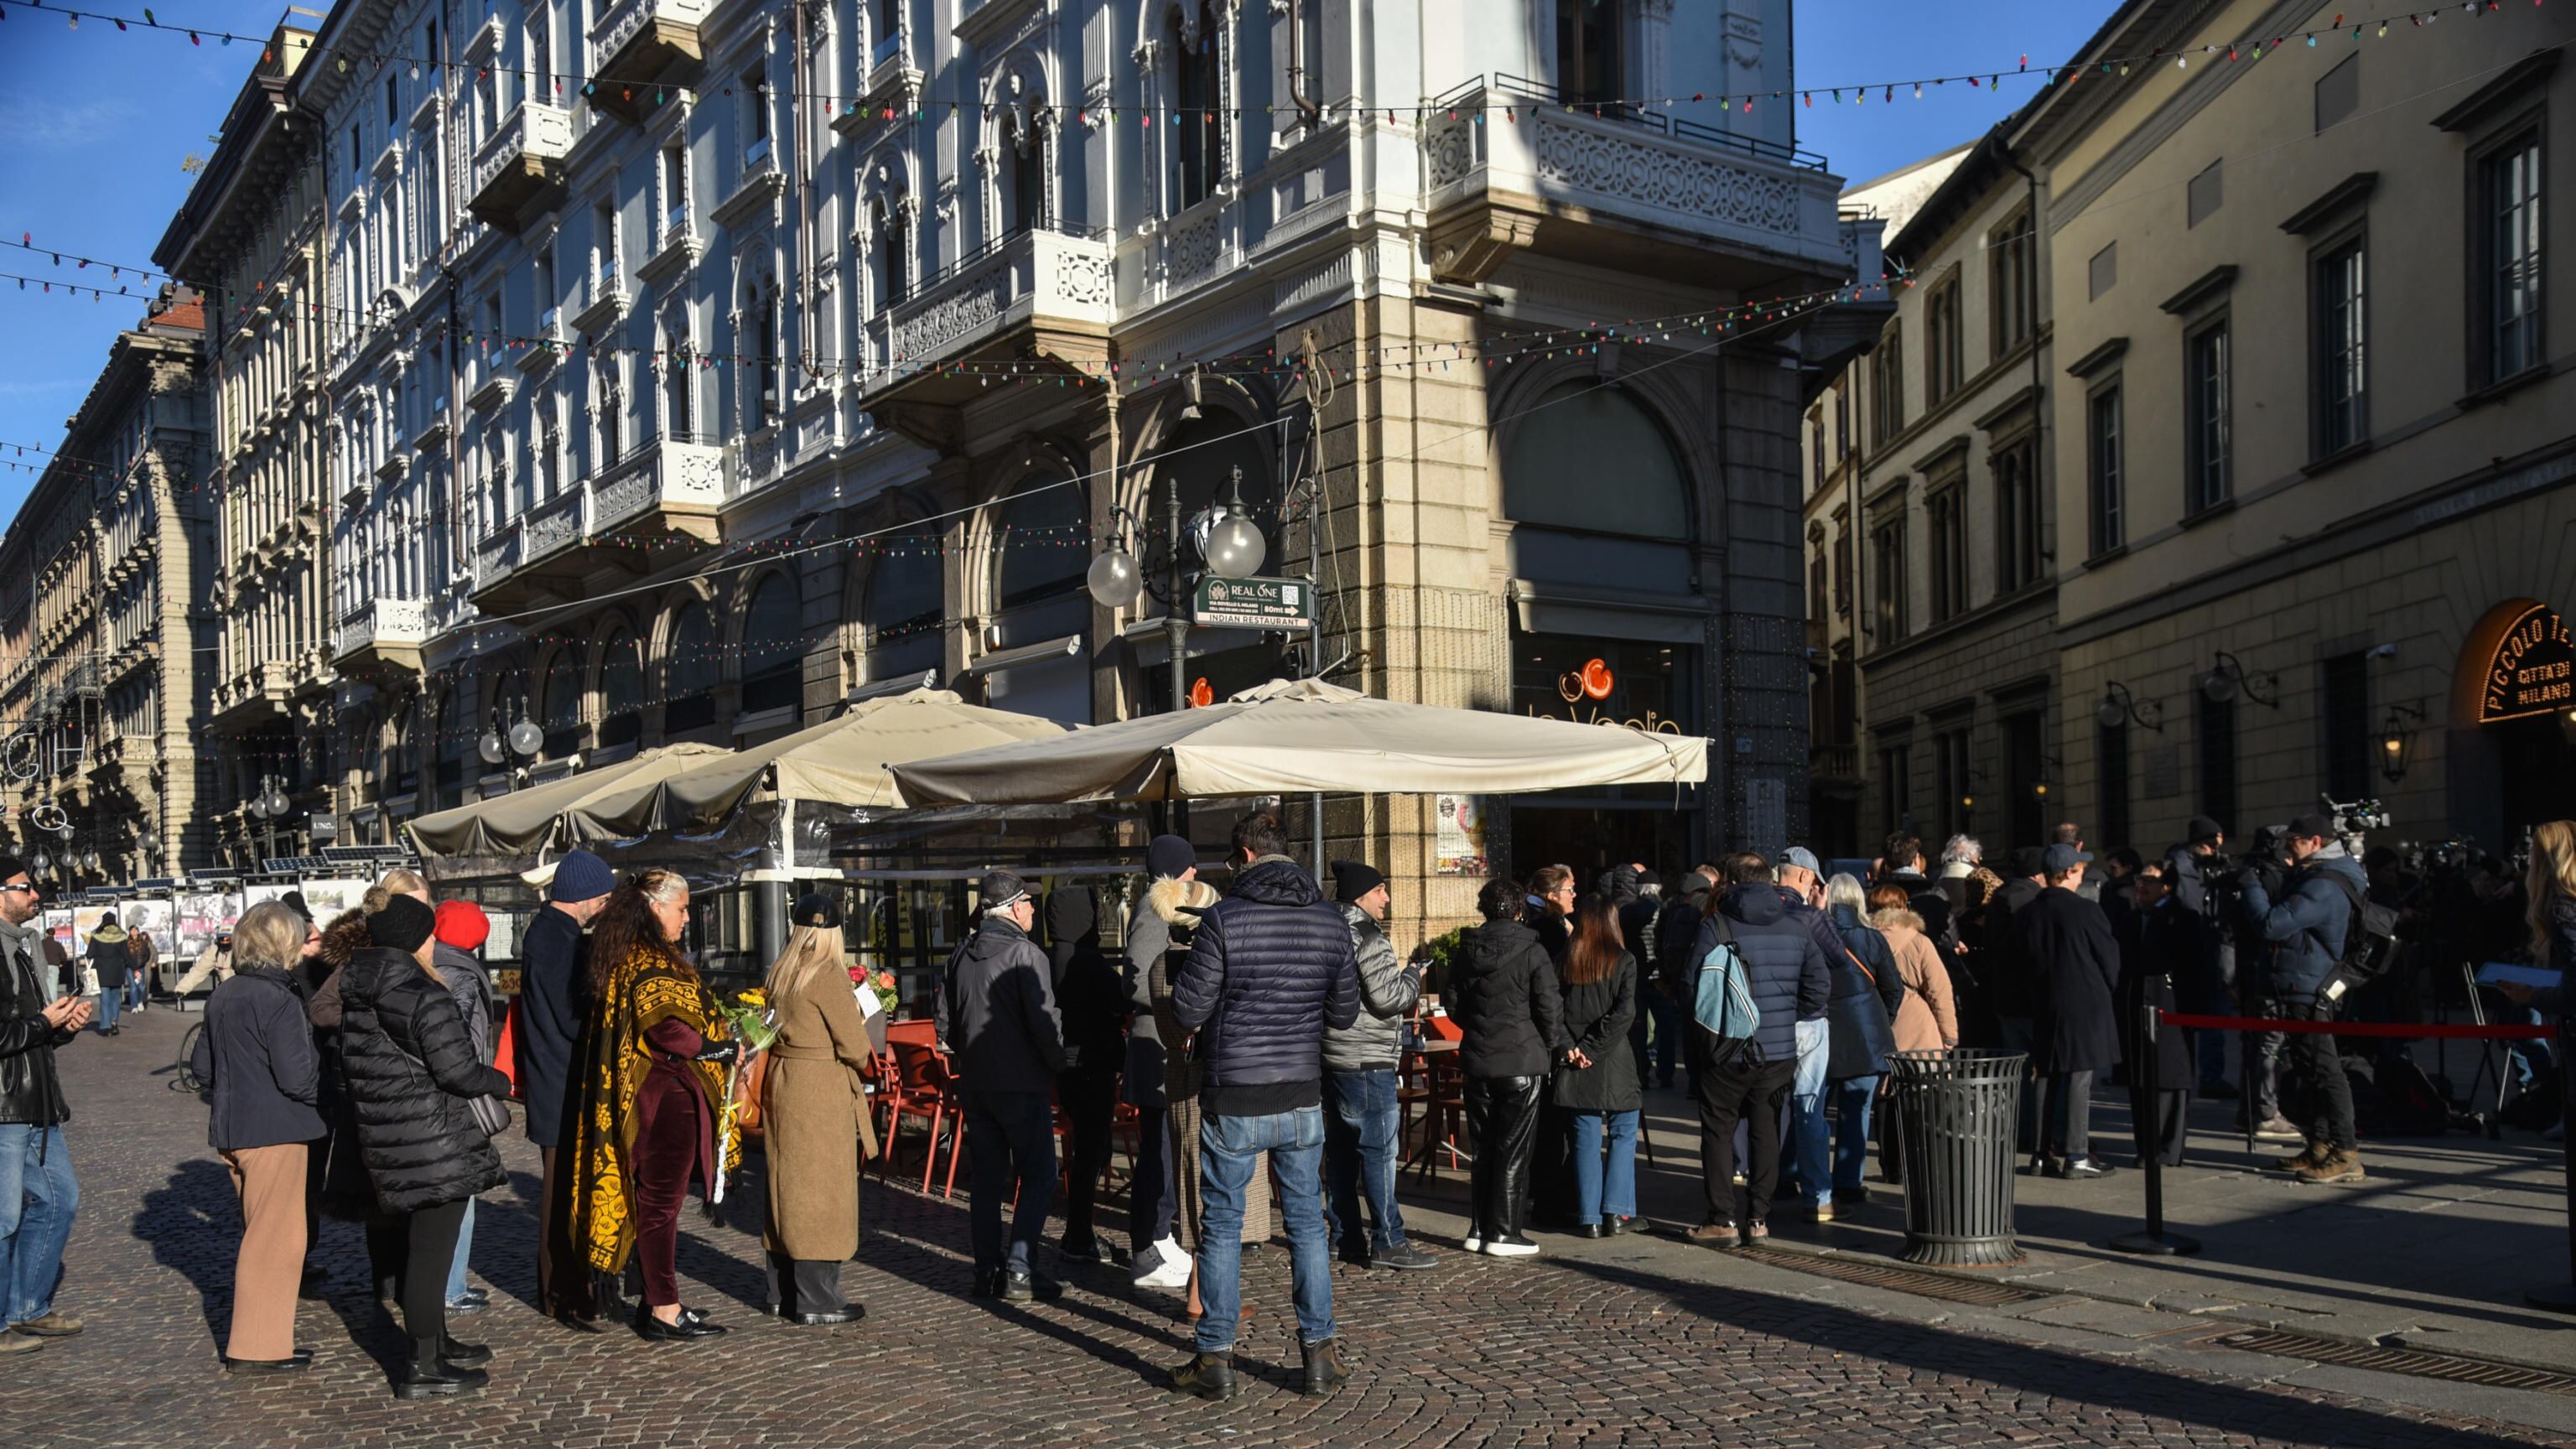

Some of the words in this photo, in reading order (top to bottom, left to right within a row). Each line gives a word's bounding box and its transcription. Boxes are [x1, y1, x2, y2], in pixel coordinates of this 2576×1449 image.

[1231, 585, 1255, 596] REAL
[1209, 614, 1240, 622] INDIAN
[1244, 616, 1299, 626] RESTAURANT
[2487, 619, 2542, 710] PICCOLO
[2517, 682, 2571, 704] MILANO
